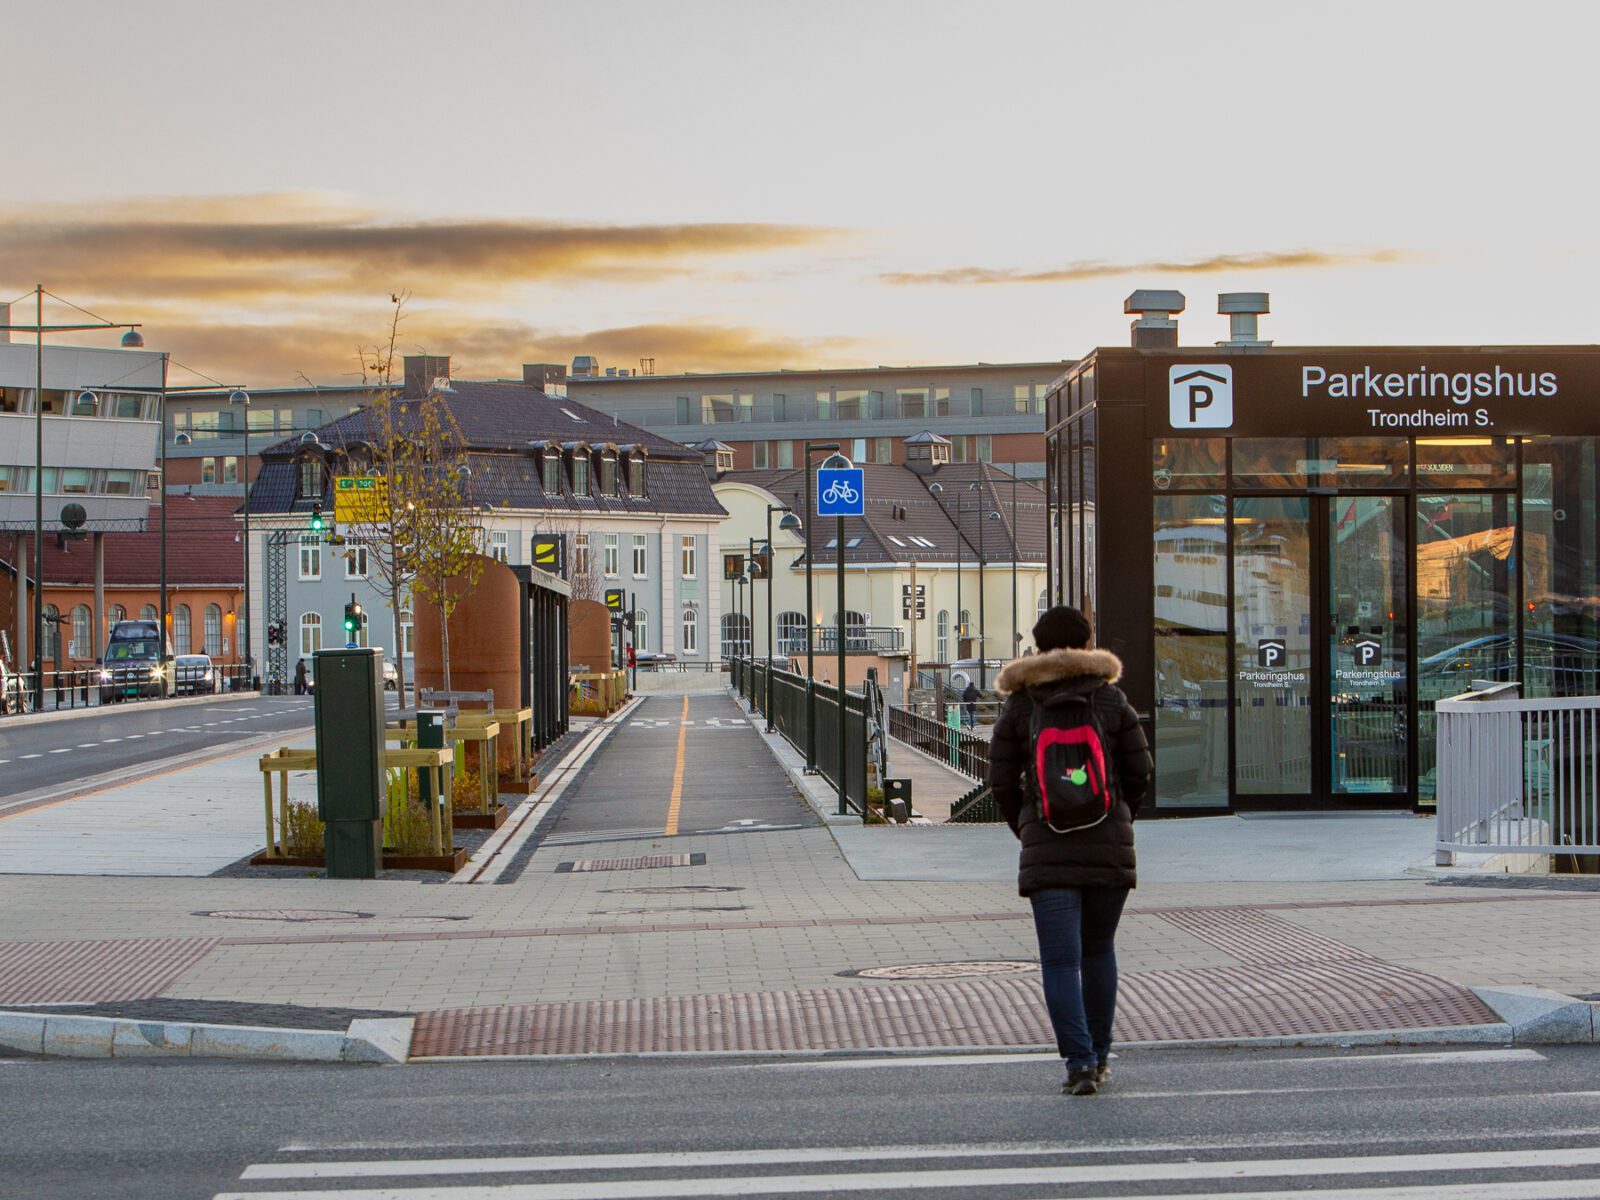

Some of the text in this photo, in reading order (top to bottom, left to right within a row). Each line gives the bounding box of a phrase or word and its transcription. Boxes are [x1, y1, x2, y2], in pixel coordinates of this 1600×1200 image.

[1302, 365, 1558, 404] Parkeringshus
[1189, 385, 1214, 422] P
[1367, 408, 1494, 427] Trondheim S.
[1266, 649, 1278, 667] P
[1362, 647, 1374, 665] P
[1239, 671, 1305, 681] Parkeringshus
[1335, 669, 1401, 680] Parkeringshus
[1349, 679, 1380, 687] Trondheim
